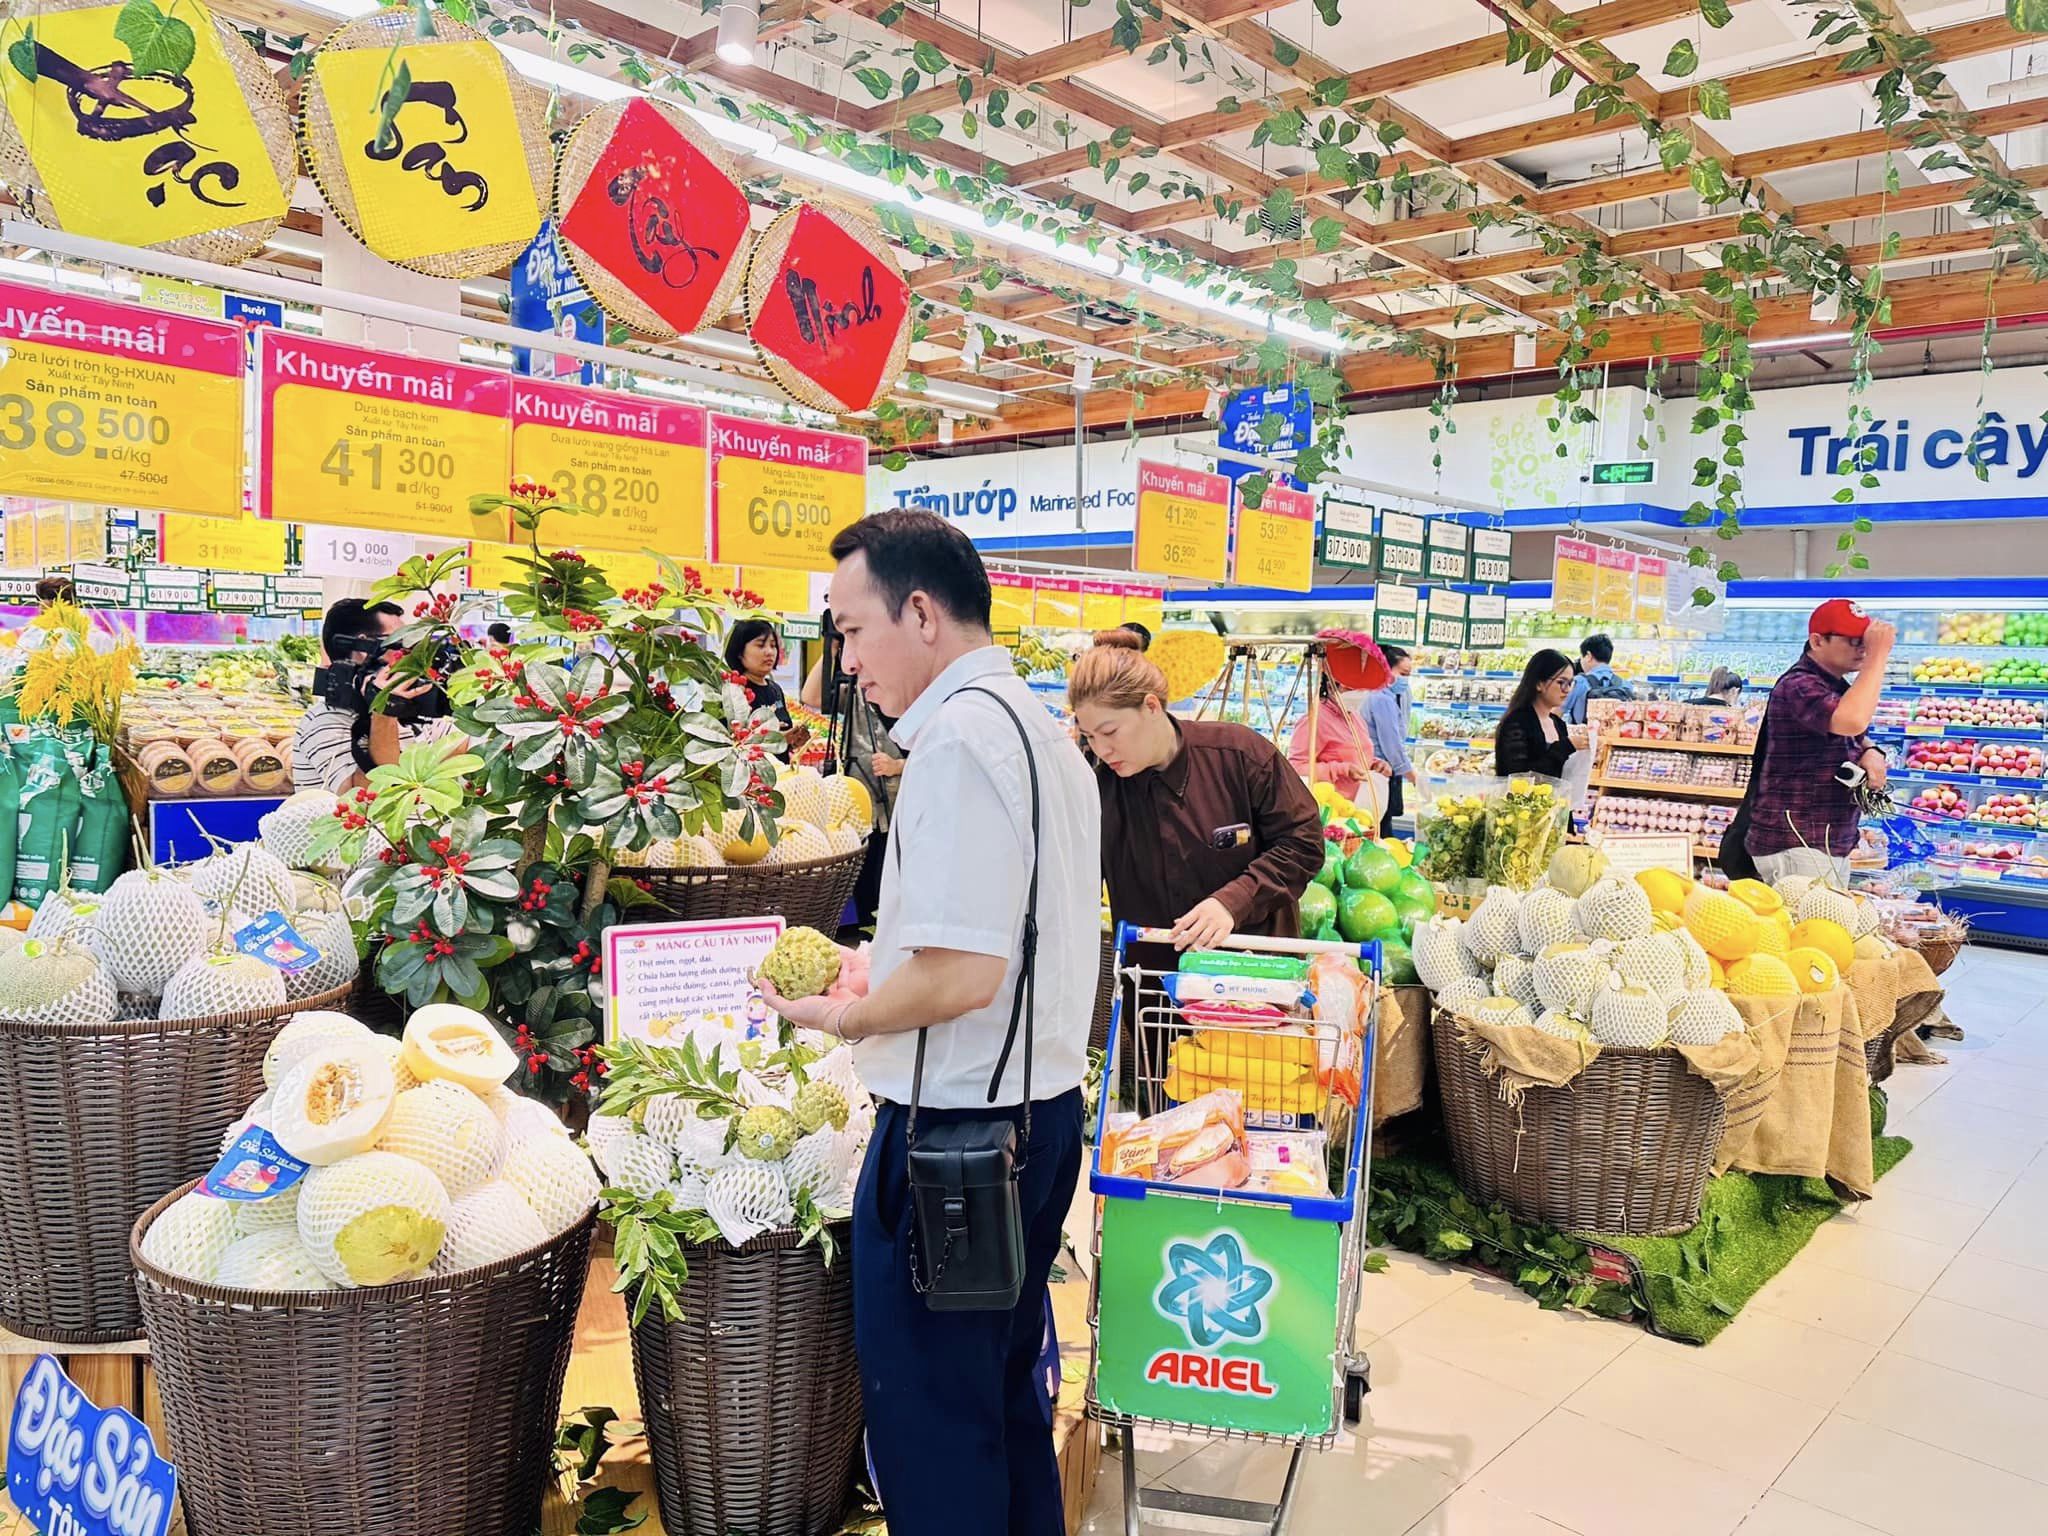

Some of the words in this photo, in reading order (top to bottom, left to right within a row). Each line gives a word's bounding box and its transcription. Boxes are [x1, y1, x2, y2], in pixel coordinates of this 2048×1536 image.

[101, 324, 166, 355] mãi
[276, 349, 392, 392] Khuyến
[403, 374, 453, 401] mãi
[105, 392, 125, 404] an
[127, 395, 158, 410] toàn
[515, 392, 609, 428] Khuyến
[617, 411, 659, 435] mãi
[405, 435, 419, 446] an
[719, 429, 792, 459] Khuyến
[798, 446, 830, 465] mãi
[1788, 419, 1910, 477] Trái
[1922, 411, 2048, 479] cây
[1141, 469, 1185, 493] Khuyến
[893, 484, 949, 518] Tẩm
[953, 479, 1017, 522] ướp
[1030, 490, 1101, 513] Marinaed
[743, 935, 772, 945] NINH
[1148, 1352, 1273, 1395] ARIEL
[16, 1358, 84, 1491] Đặc
[83, 1413, 163, 1536] Sản
